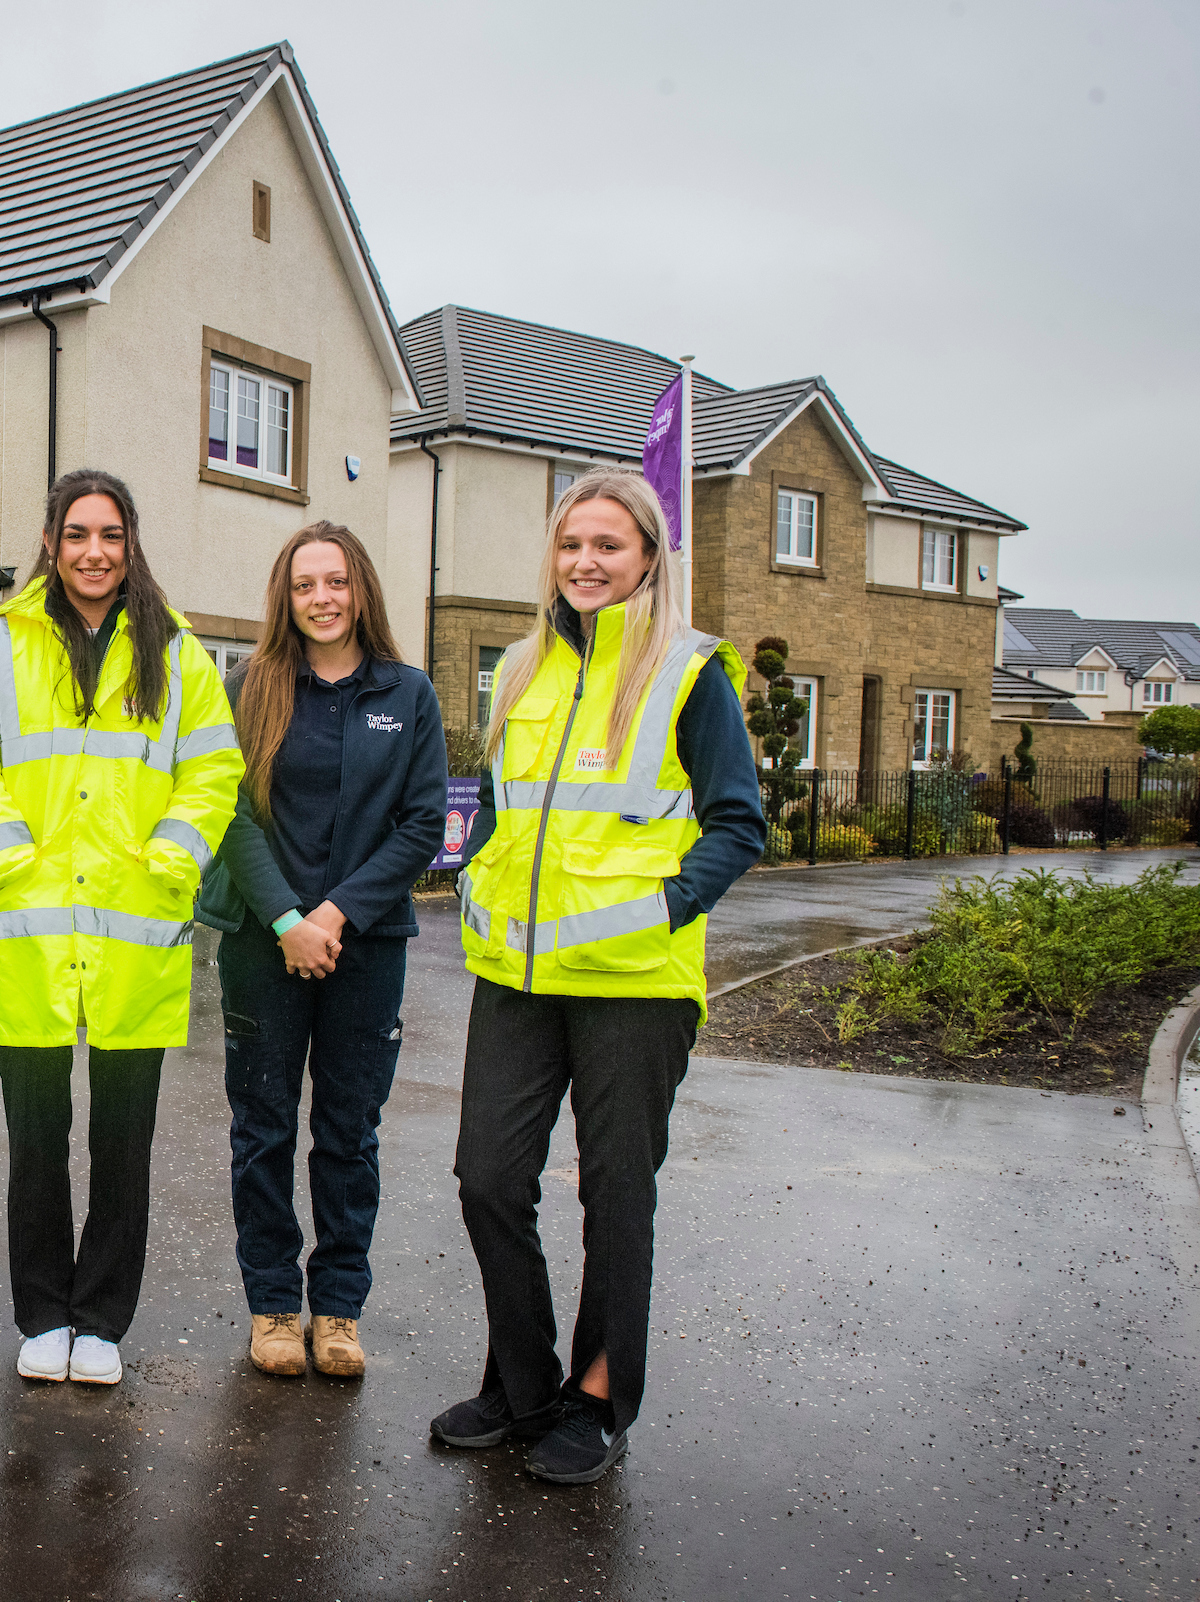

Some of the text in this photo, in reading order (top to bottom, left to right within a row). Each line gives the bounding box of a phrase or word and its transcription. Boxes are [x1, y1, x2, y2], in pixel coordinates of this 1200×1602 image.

[366, 713, 394, 725] Taylor
[367, 721, 403, 732] Wimpey
[579, 750, 606, 761] Taylo
